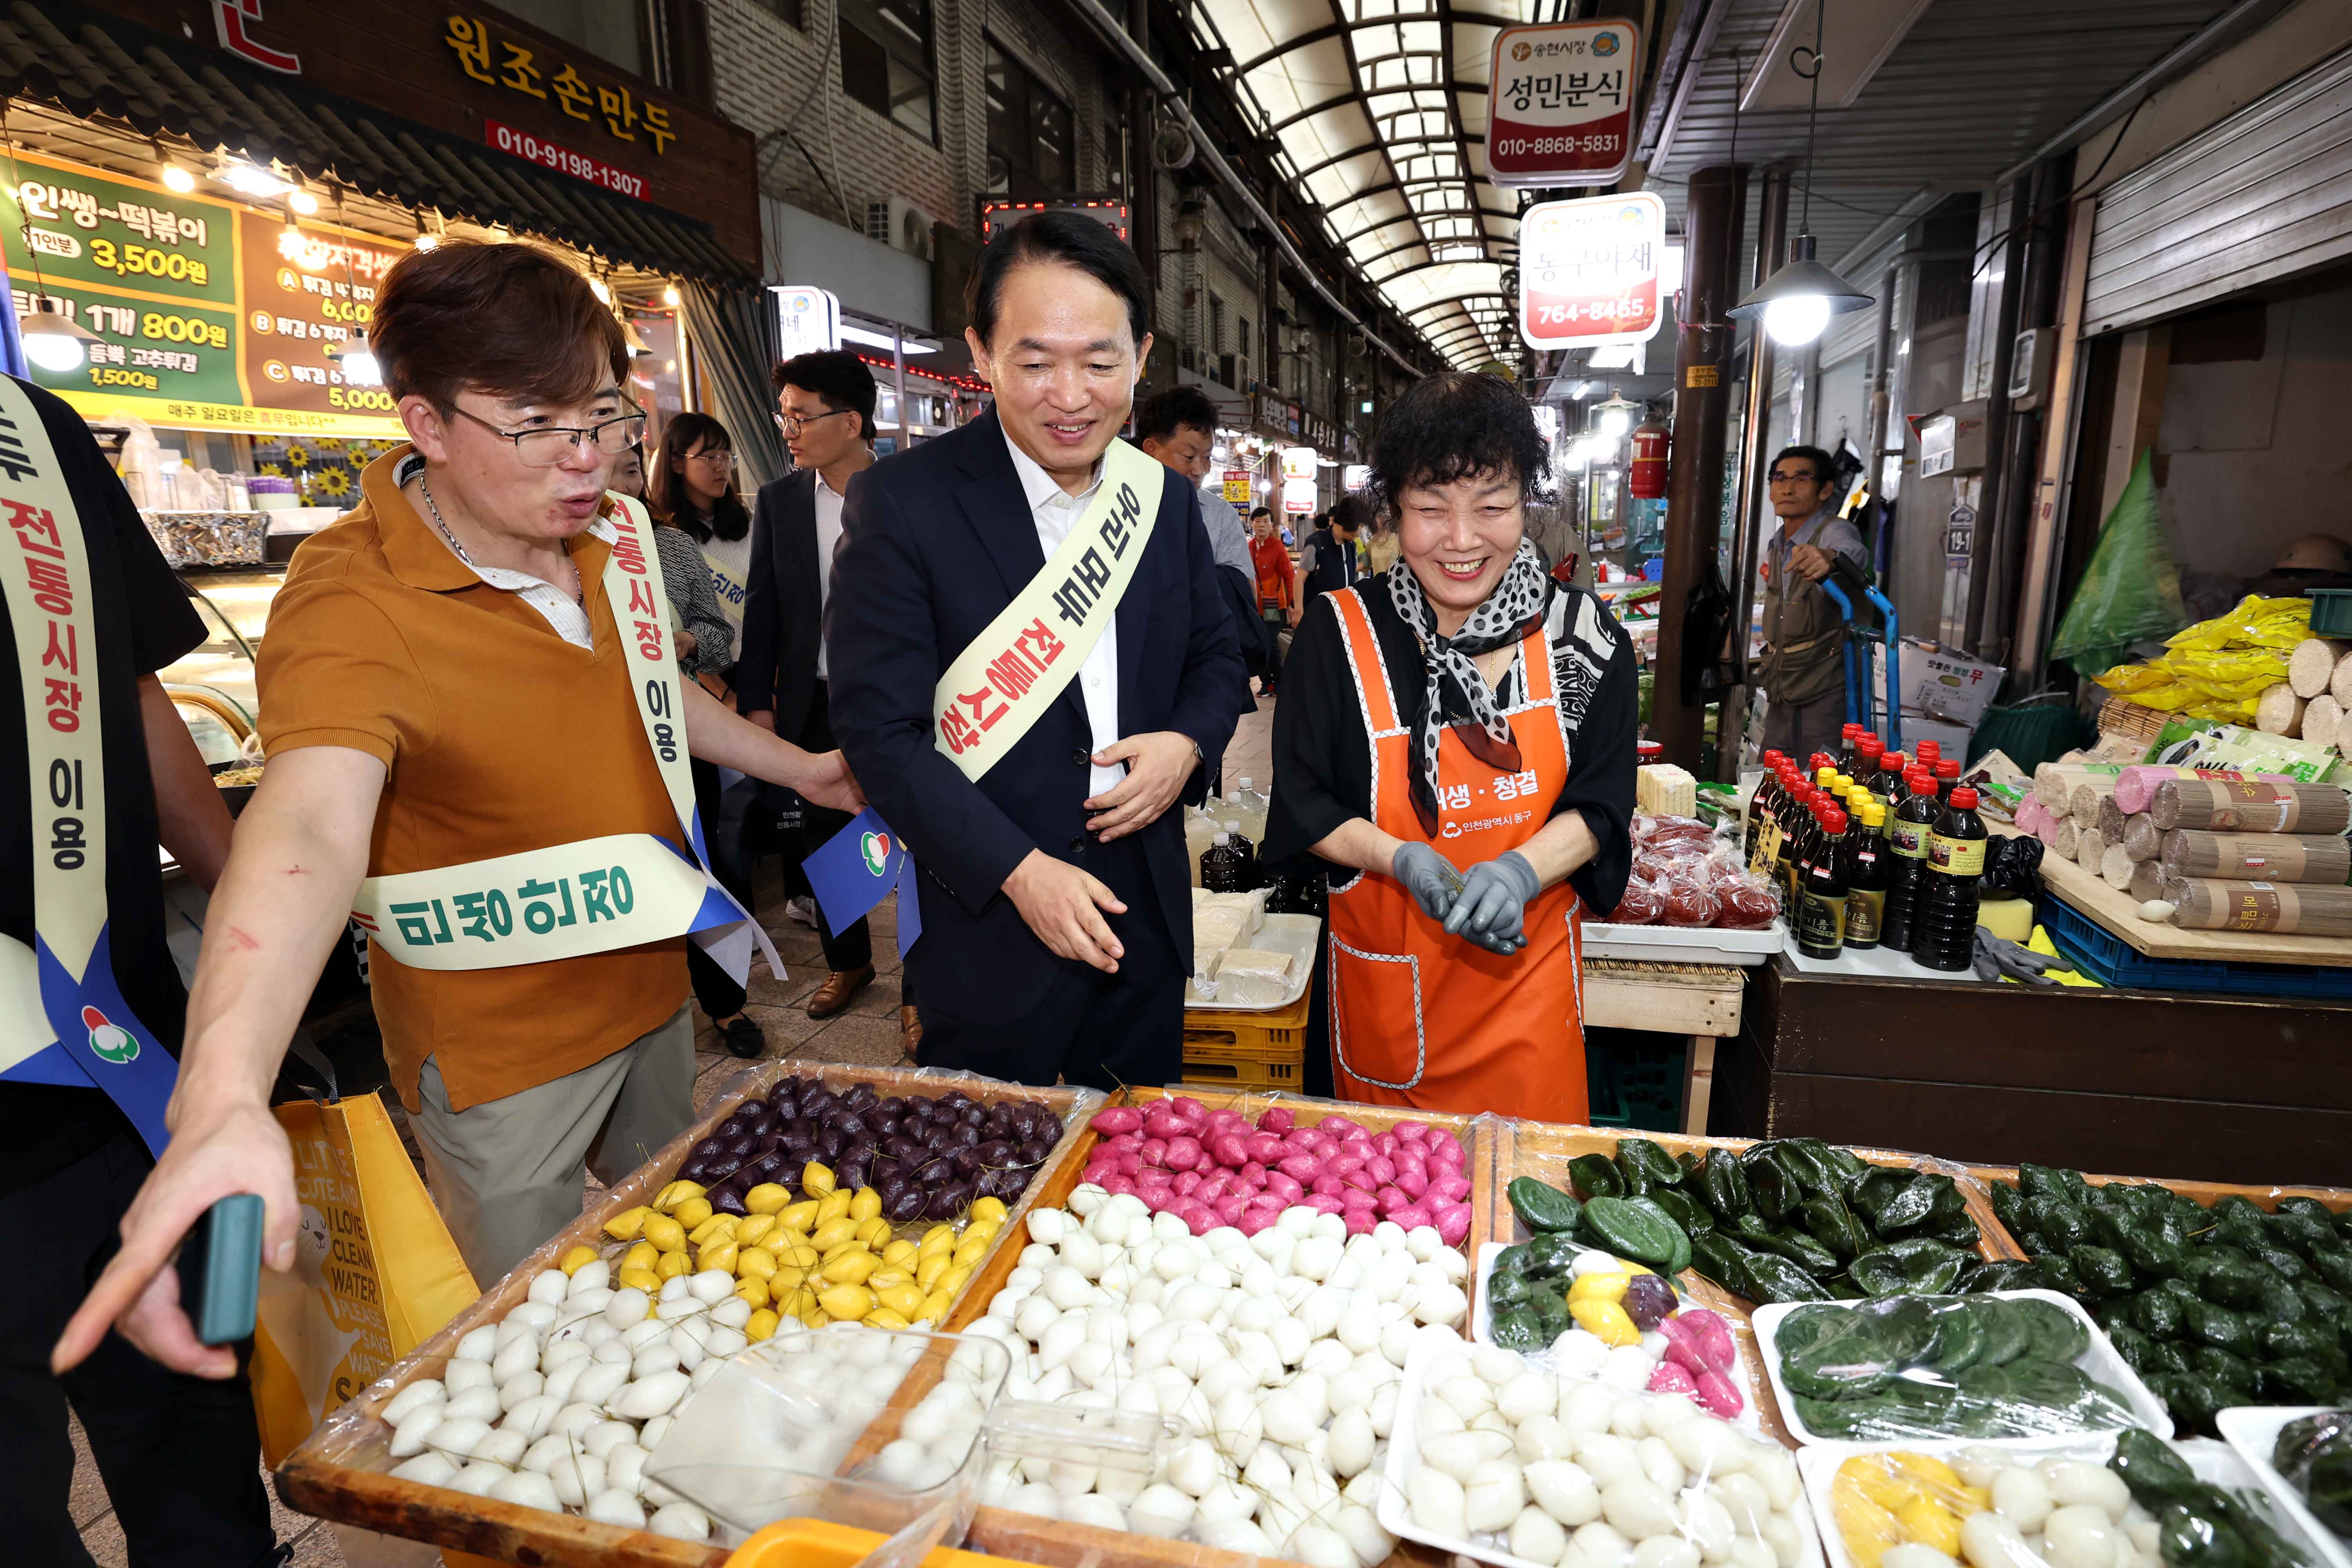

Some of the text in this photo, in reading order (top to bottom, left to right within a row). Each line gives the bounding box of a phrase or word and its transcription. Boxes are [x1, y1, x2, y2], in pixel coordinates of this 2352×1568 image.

[1533, 40, 1586, 57] 송현시장
[1504, 70, 1623, 111] 성민분식
[1498, 134, 1619, 156] 010-8868-5831
[496, 127, 642, 198] 010-9198-1307
[33, 232, 72, 254] 1인분
[89, 238, 207, 285] 3,500원
[1534, 241, 1651, 282] 동구야채
[282, 271, 297, 289] A
[301, 274, 333, 297] 튀김
[84, 304, 136, 336] 1개
[142, 312, 228, 348] 800원
[256, 314, 269, 331] B
[276, 316, 307, 339] 튀김
[1538, 298, 1644, 325] 764-8465
[130, 348, 198, 373] 고추튀김
[268, 364, 285, 379] C
[290, 365, 327, 385] 튀김
[88, 367, 159, 390] 1,500원
[168, 404, 197, 418] 매주
[201, 407, 255, 423] 일요일은
[1951, 531, 1971, 551] 19-1
[0, 497, 82, 733] 전통시장
[49, 758, 86, 871] 이용
[940, 617, 1066, 755] 전통시장
[646, 680, 677, 763] 이용
[1492, 769, 1539, 801] 청결
[1462, 810, 1532, 832] 인천광역시 동구
[389, 865, 634, 946] 민생안정
[327, 1207, 366, 1241] I LOVE
[333, 1238, 373, 1272] CLEAN
[331, 1267, 378, 1305] WATER.
[338, 1298, 386, 1332] PLEASE
[361, 1328, 392, 1358] SAVE
